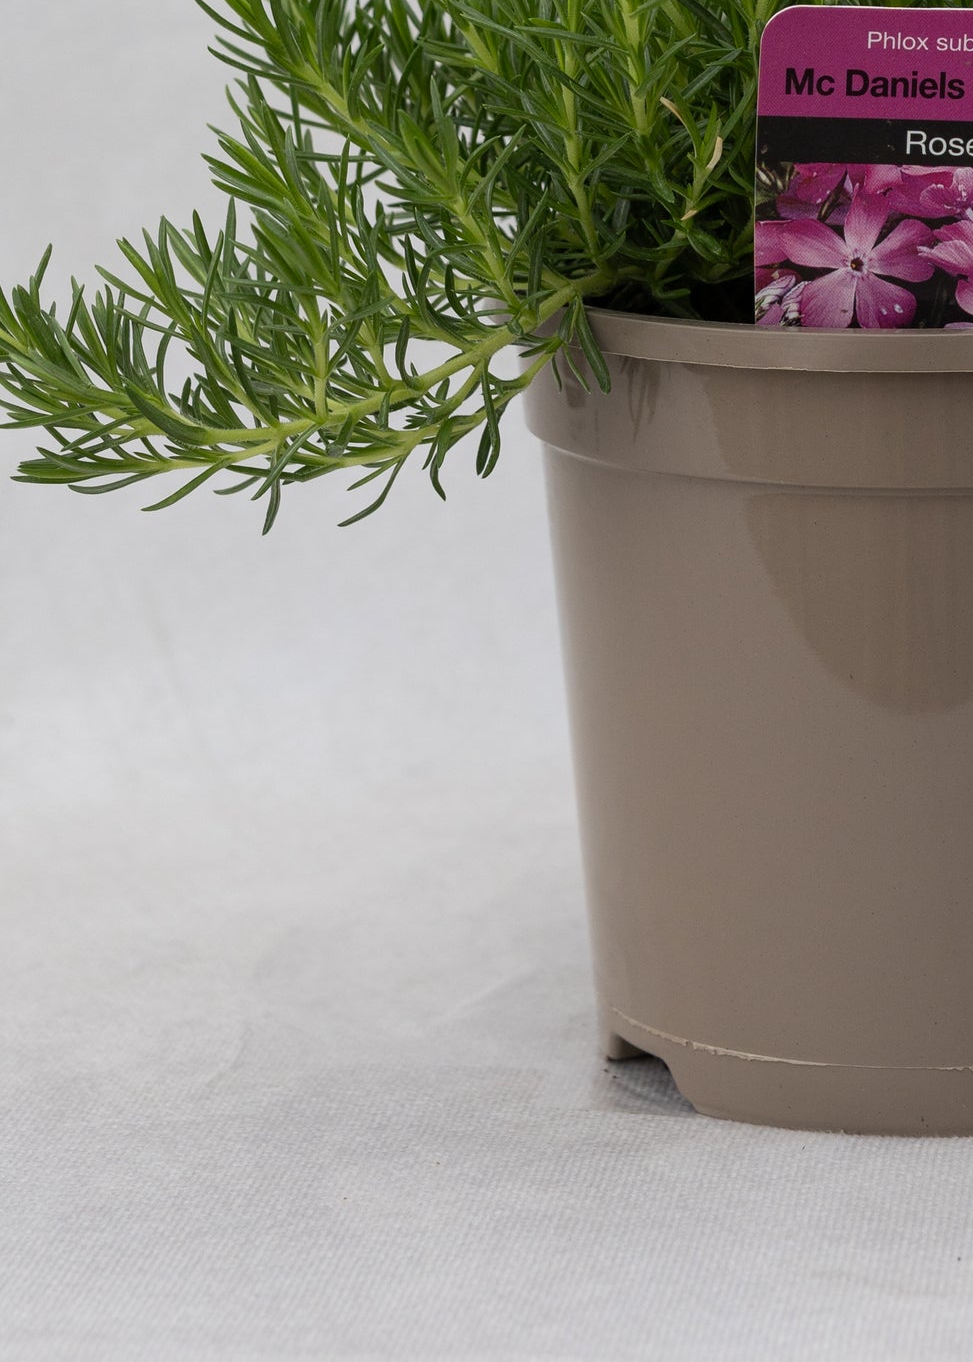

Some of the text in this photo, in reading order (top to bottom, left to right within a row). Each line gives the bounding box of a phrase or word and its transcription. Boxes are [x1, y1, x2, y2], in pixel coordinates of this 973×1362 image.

[867, 31, 929, 51] Phlox
[784, 67, 835, 96] Mc
[845, 68, 965, 100] Daniels
